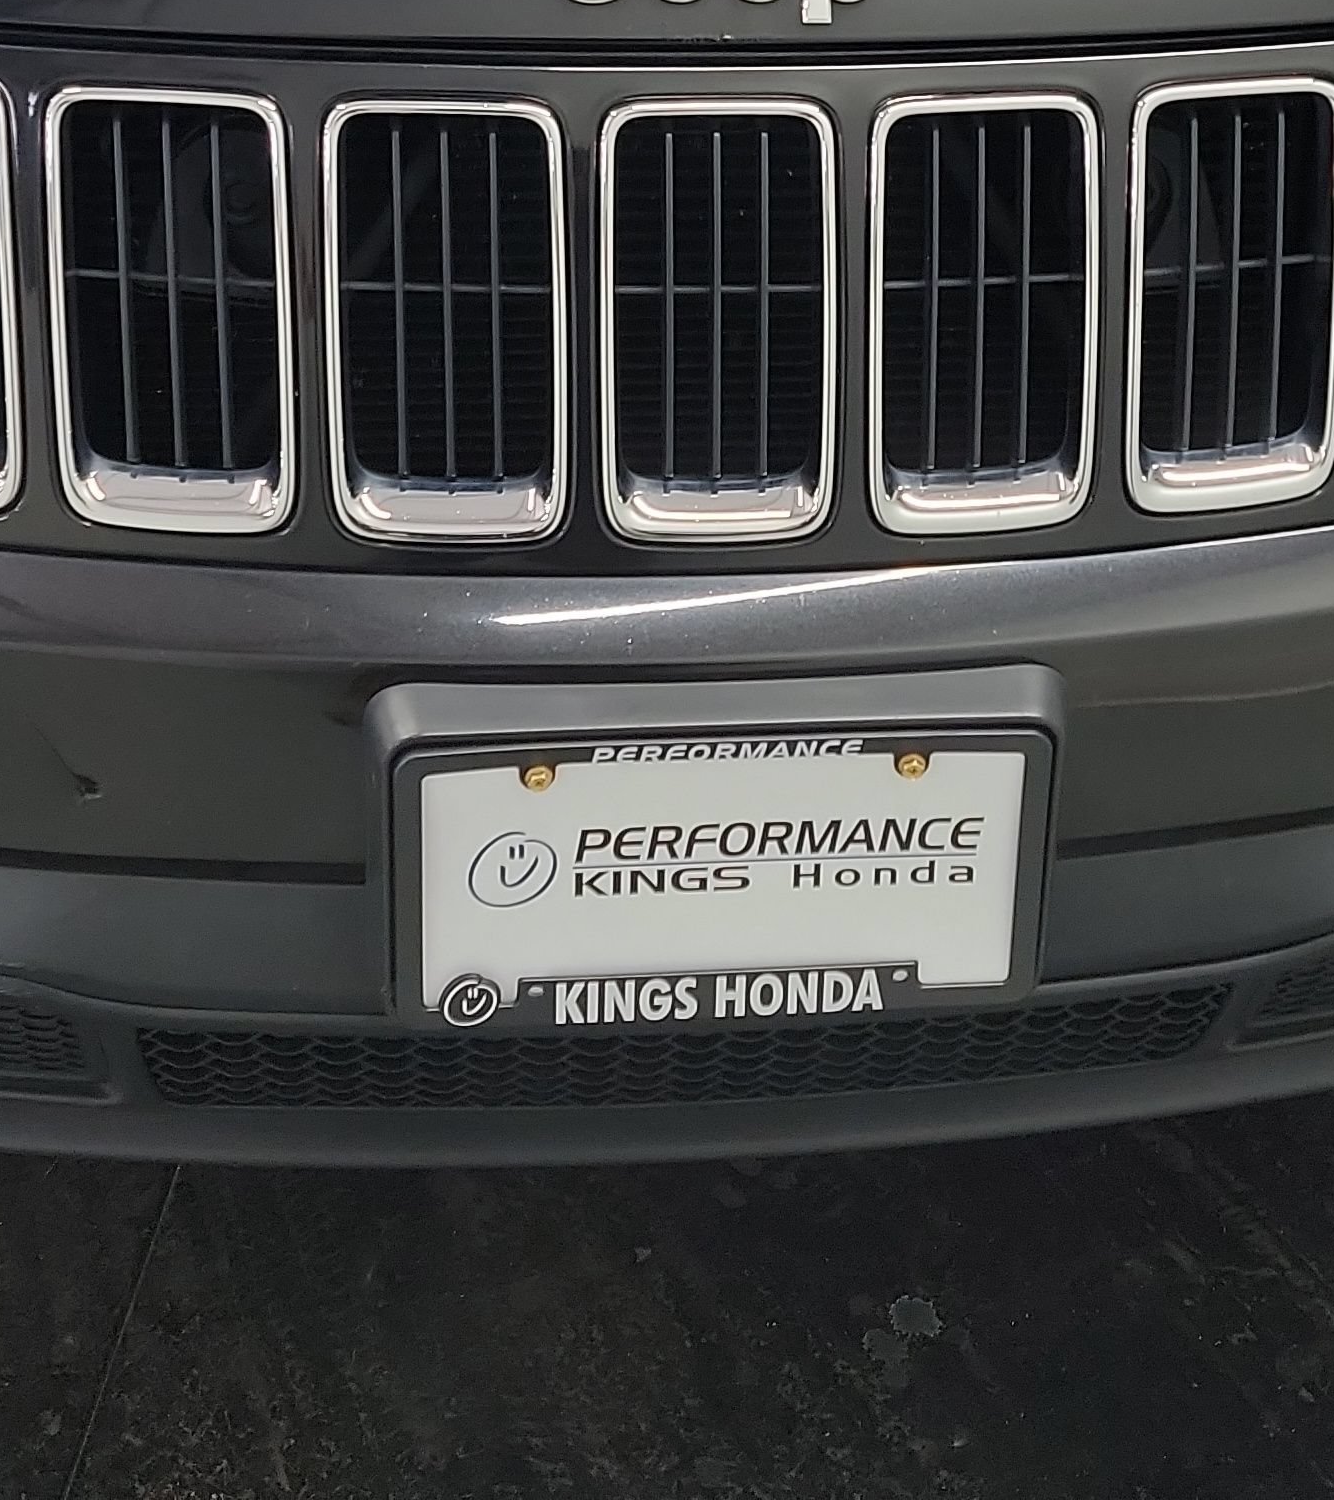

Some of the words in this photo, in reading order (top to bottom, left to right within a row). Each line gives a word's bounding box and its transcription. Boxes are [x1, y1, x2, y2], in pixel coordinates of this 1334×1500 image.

[592, 738, 865, 765] PERFORMANCE
[574, 816, 985, 865] PERFORMANCE
[574, 865, 751, 898] KINGS
[792, 860, 975, 890] Honda
[555, 976, 698, 1025] KINGS
[715, 968, 884, 1018] HONDA
